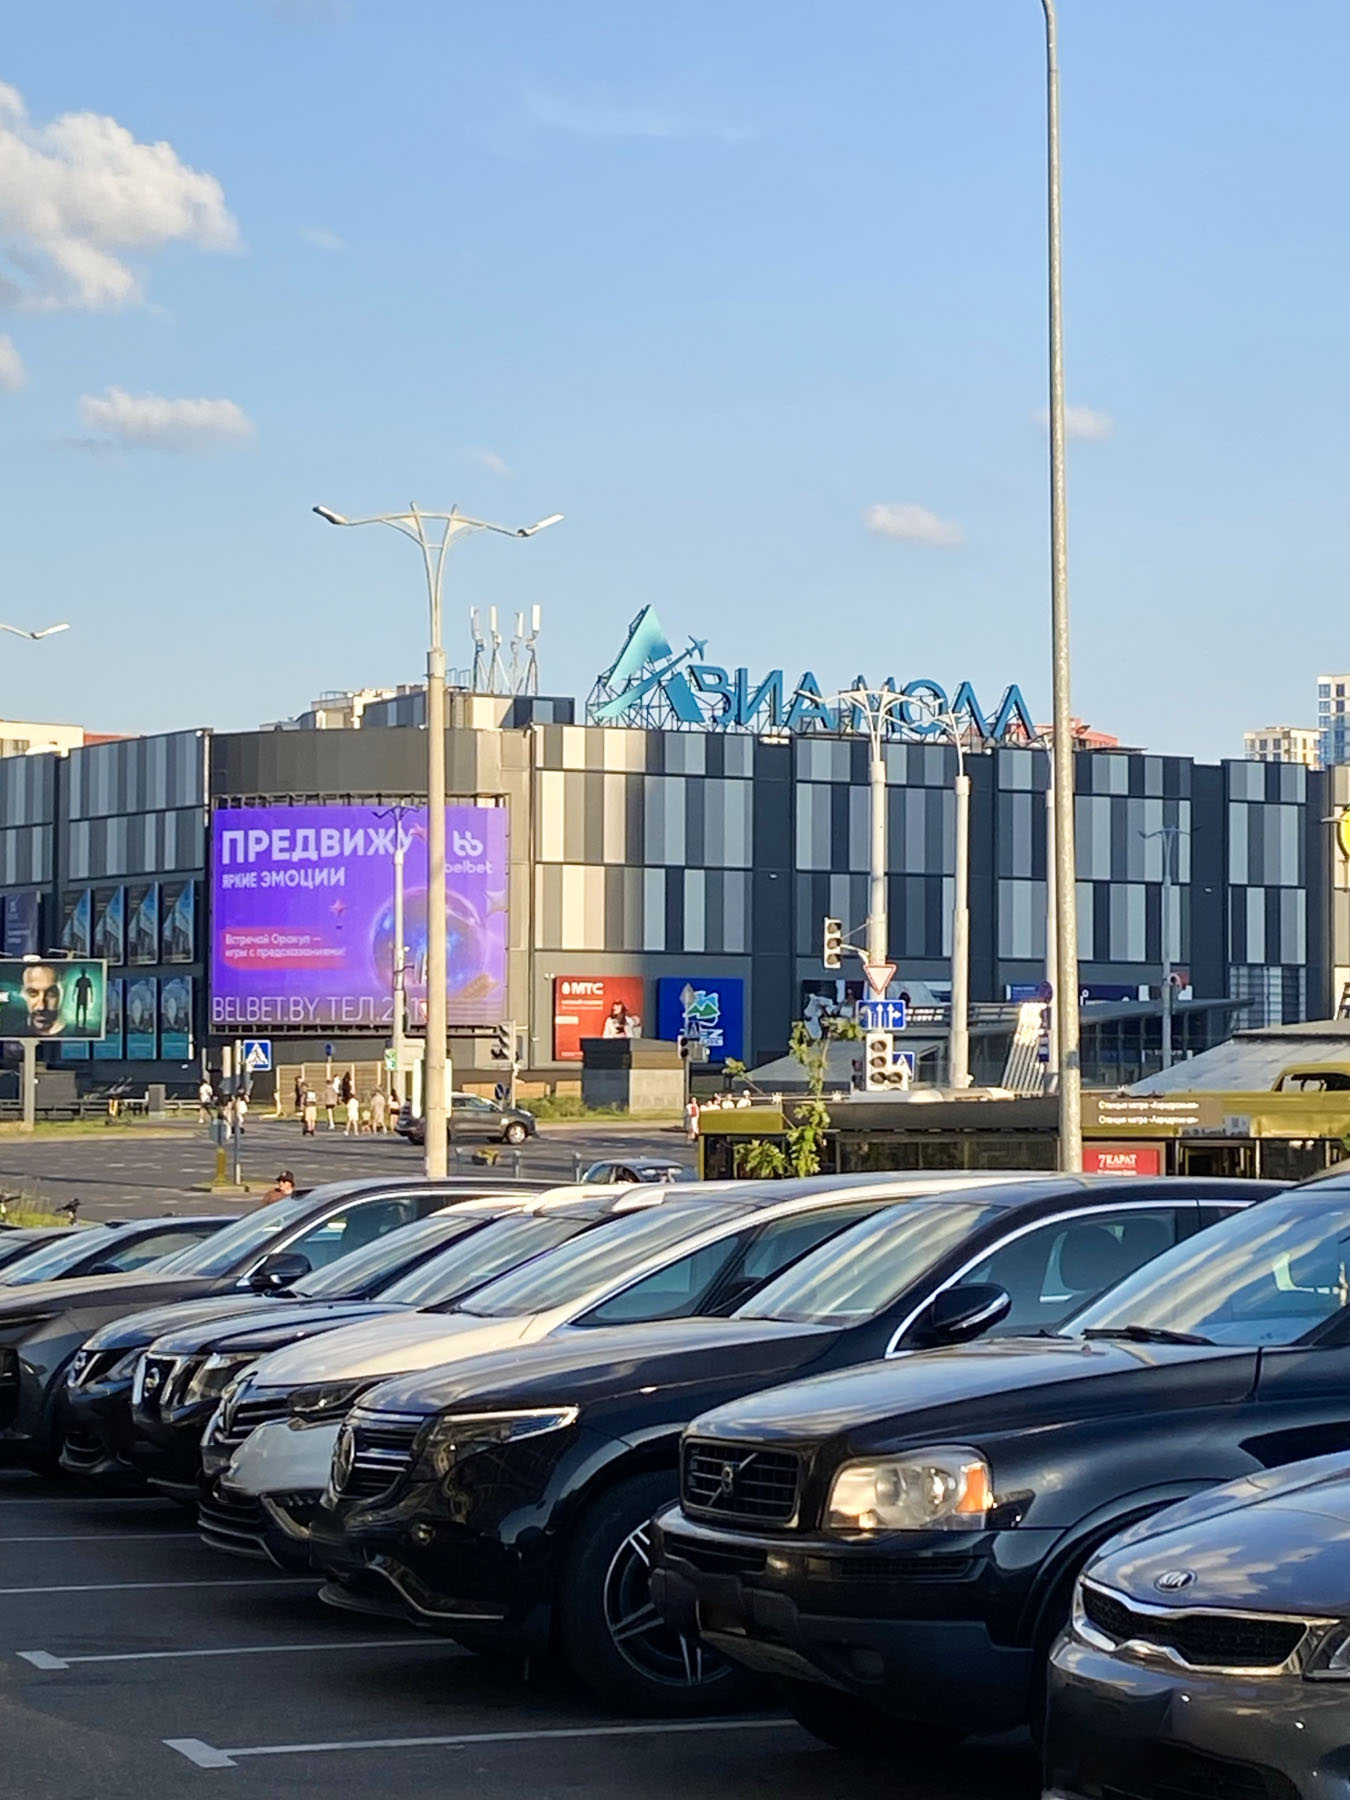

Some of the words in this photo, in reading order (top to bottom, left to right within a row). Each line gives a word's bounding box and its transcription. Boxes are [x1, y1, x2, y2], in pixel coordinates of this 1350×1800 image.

[222, 827, 413, 864] ПРЕДВИЖУ
[222, 872, 257, 888] ЯРКИЕ
[261, 867, 345, 889] ЭМОЦИИ
[571, 982, 604, 995] МТС
